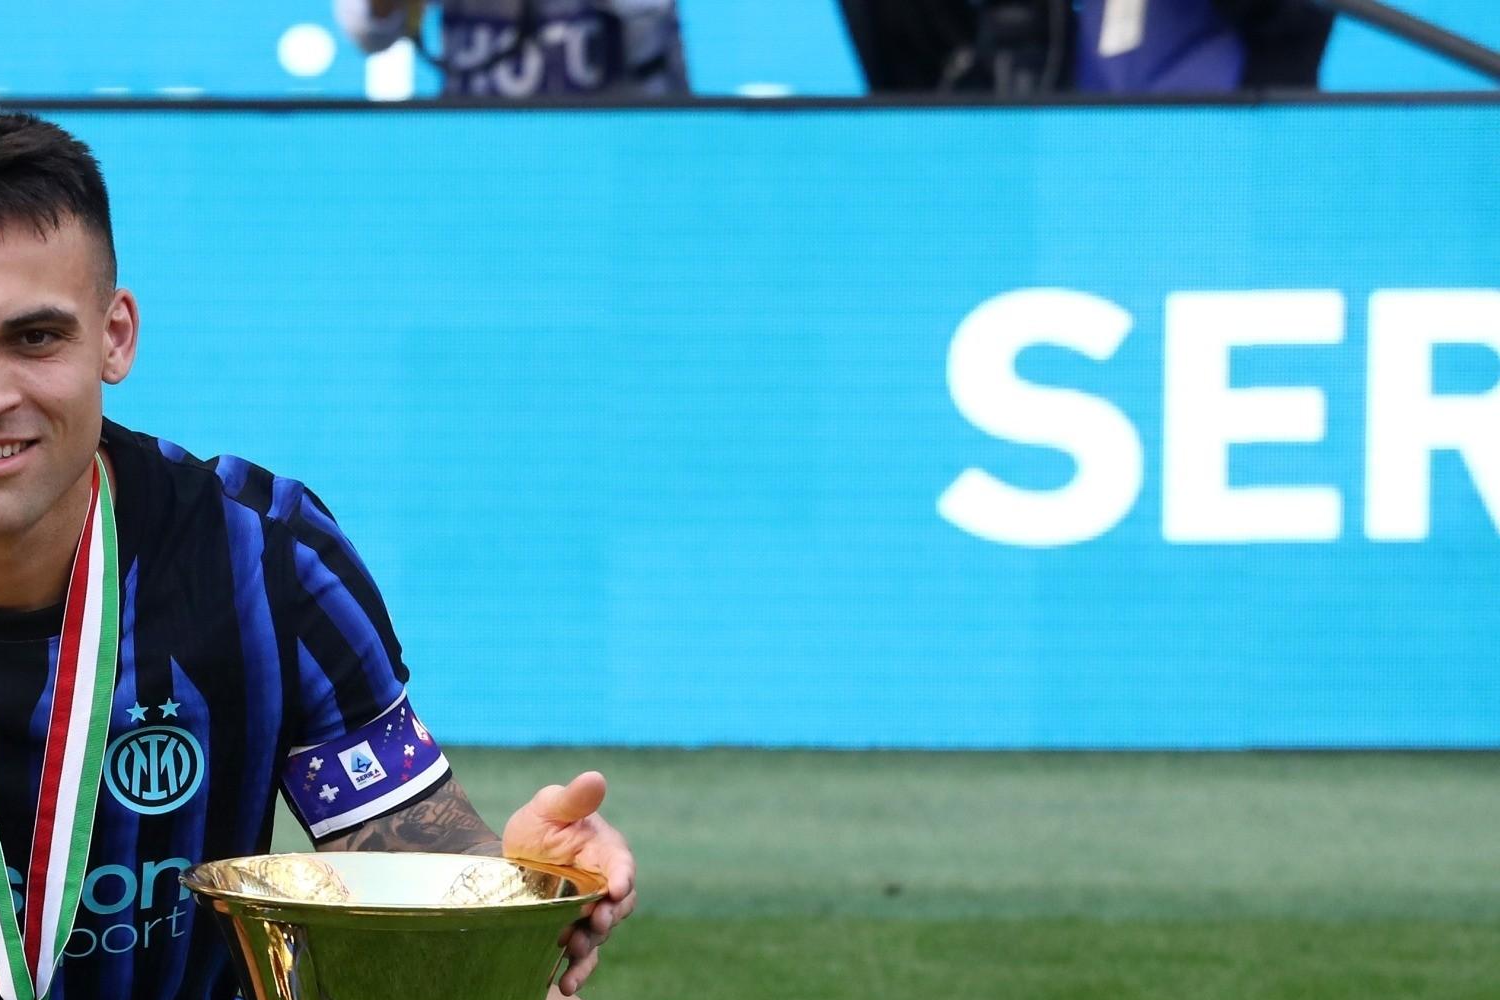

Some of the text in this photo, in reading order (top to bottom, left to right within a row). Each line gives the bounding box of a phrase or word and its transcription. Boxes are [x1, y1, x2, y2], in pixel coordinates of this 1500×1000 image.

[936, 286, 1500, 547] SER
[355, 771, 373, 783] SERIE
[59, 906, 187, 968] port
